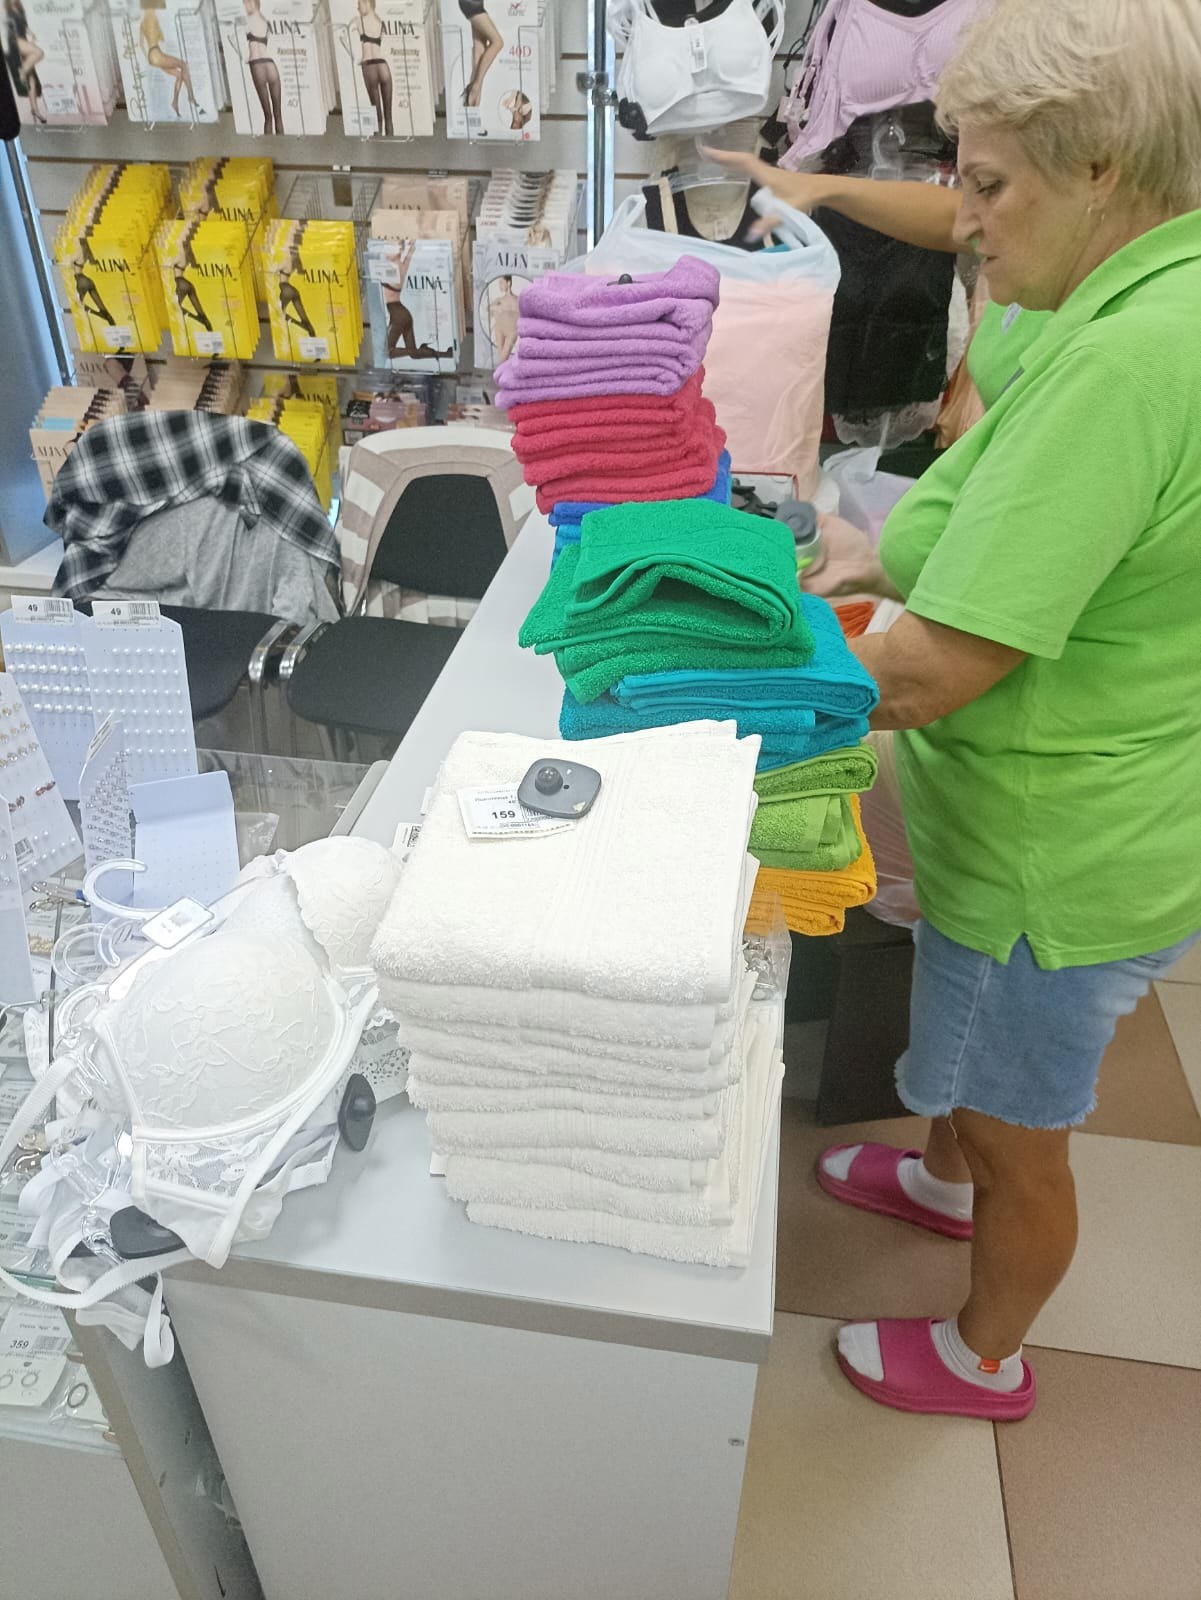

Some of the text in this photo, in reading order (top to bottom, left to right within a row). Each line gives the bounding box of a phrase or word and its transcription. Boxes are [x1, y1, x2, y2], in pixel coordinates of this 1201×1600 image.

[266, 20, 301, 35] ALINA
[380, 20, 415, 36] ALINA
[509, 46, 532, 57] 40D
[219, 208, 255, 222] ALINA
[95, 258, 131, 273] ALINA
[197, 264, 233, 278] ALINA
[303, 269, 340, 284] ALINA
[406, 275, 443, 290] ALINA
[27, 604, 38, 612] 49
[110, 607, 121, 616] 49
[491, 810, 516, 819] 159
[9, 1340, 30, 1350] 359
